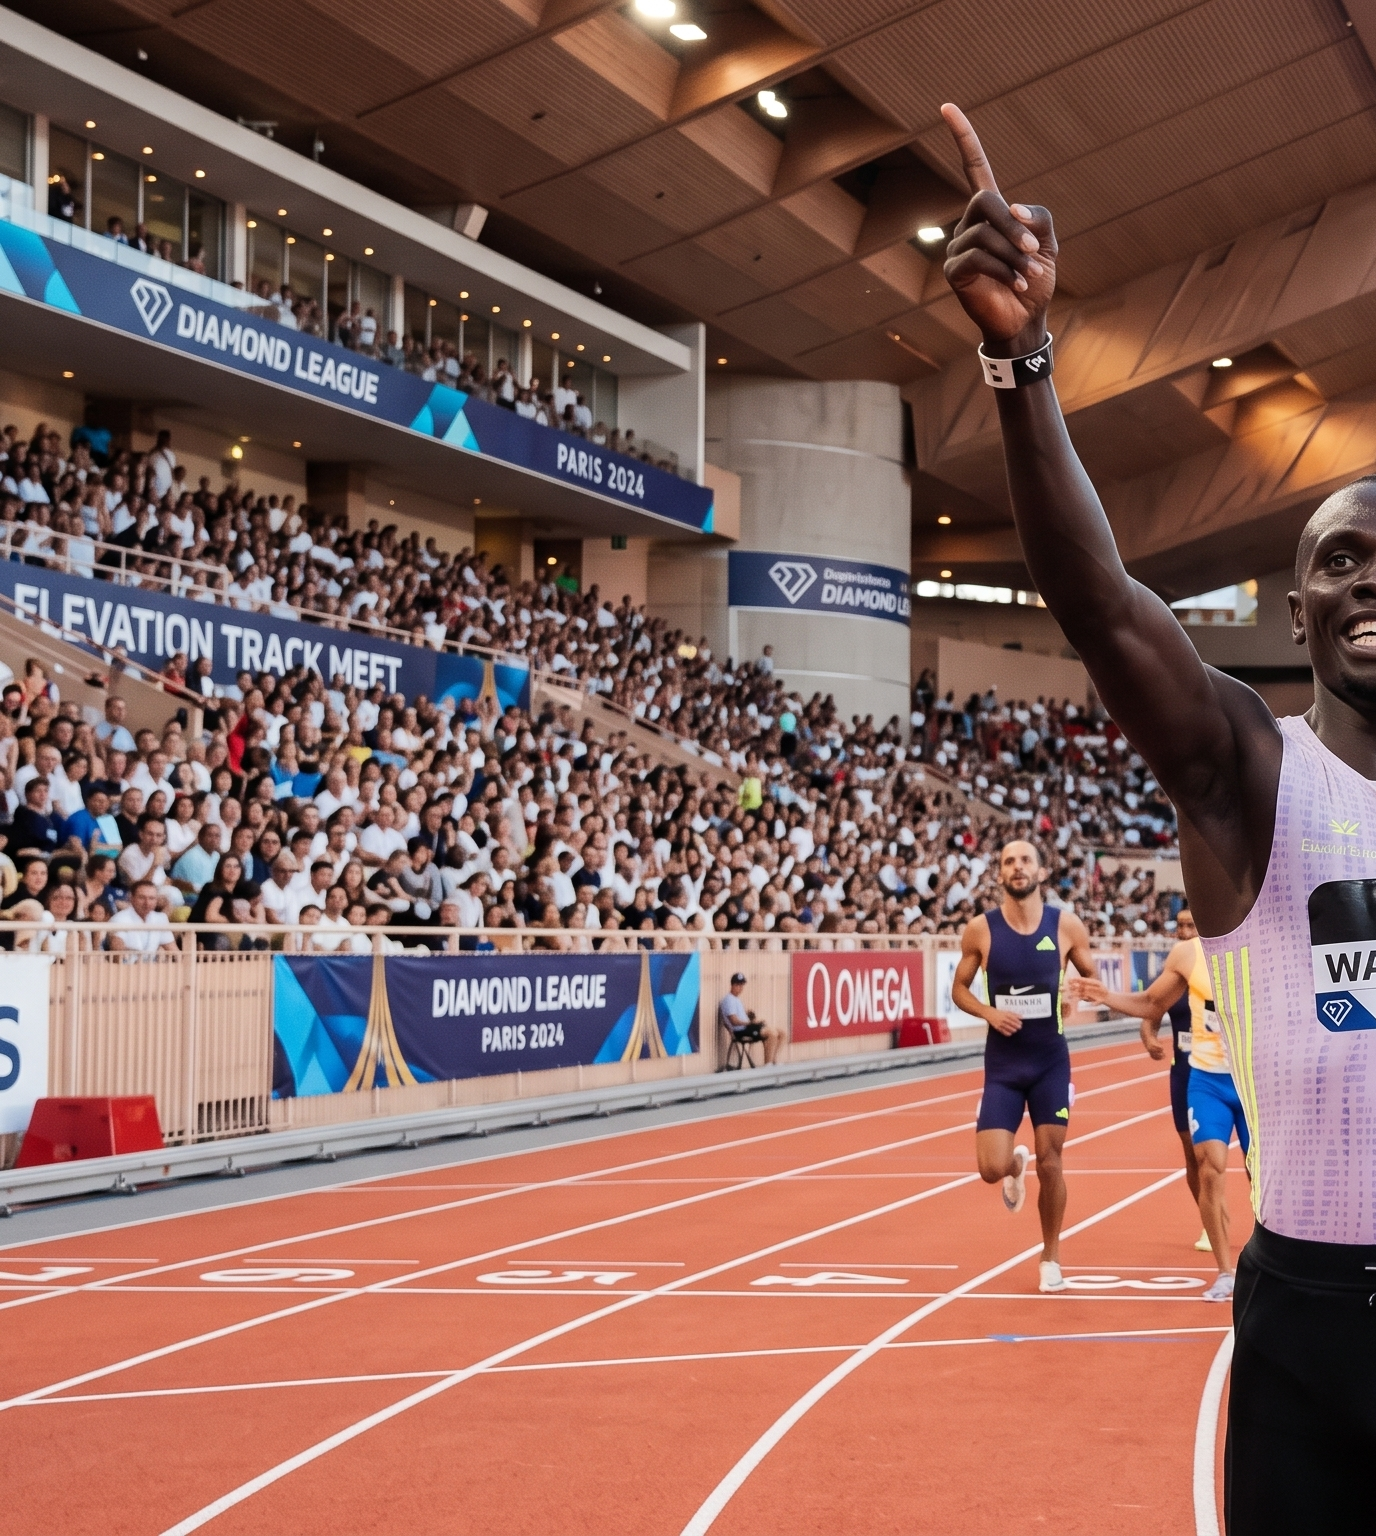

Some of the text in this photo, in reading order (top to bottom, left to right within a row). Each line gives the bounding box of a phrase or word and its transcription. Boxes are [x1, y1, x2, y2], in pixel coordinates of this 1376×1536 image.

[176, 303, 380, 404] DIAMOND LEAGUE
[556, 442, 645, 499] PARIS 2024
[820, 583, 898, 613] DIAMOND
[14, 582, 403, 695] ELEVATION TRACK MEET
[432, 974, 607, 1018] DIAMOND LEAGUE
[835, 965, 915, 1027] OMEGA
[481, 1022, 565, 1053] PARIS 2024
[475, 1270, 639, 1285] 5
[749, 1271, 910, 1287] 4
